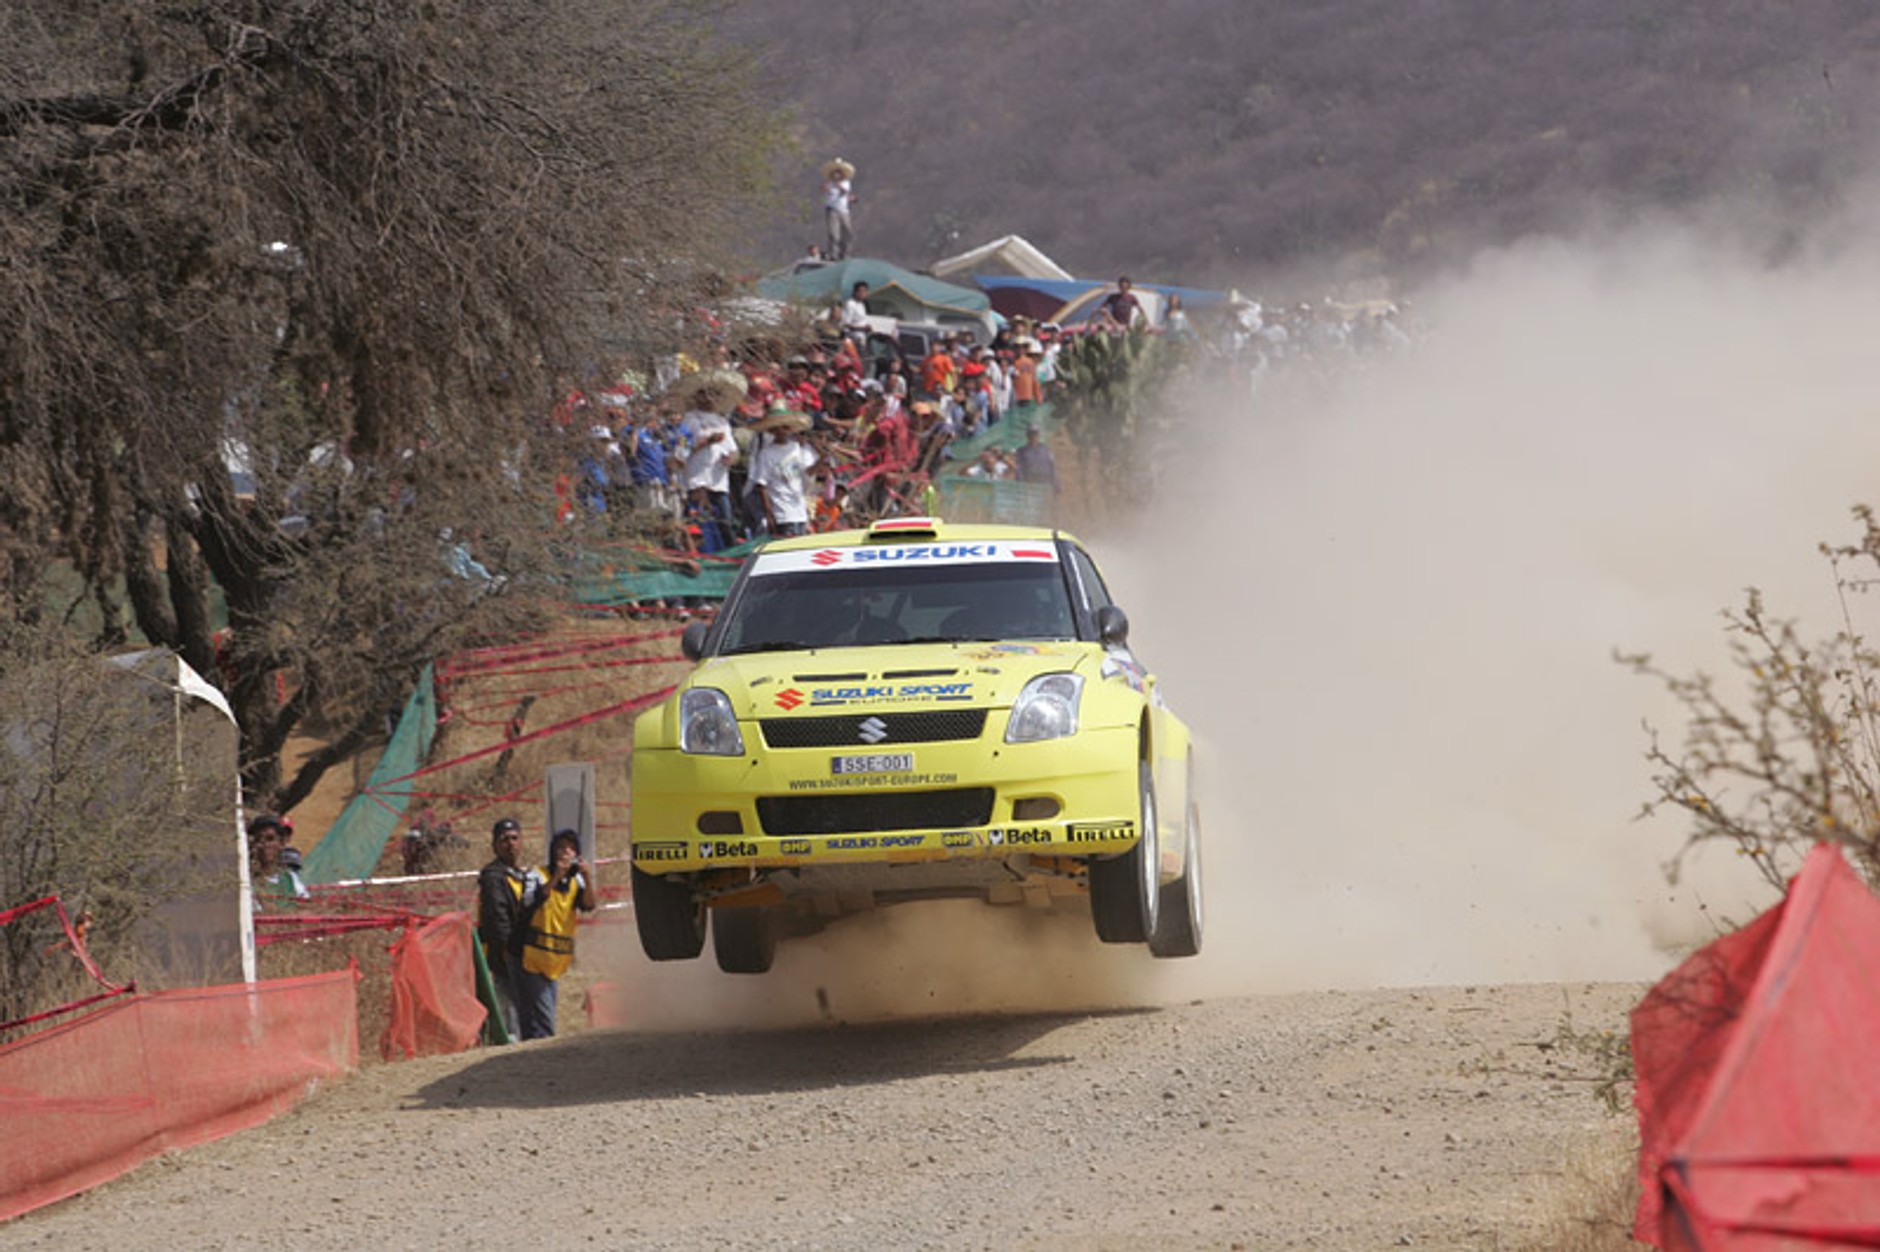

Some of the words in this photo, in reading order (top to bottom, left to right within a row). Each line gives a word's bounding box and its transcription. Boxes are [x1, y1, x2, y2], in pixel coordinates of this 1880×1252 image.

[853, 545, 997, 561] SUZUKI
[811, 686, 893, 699] SUZUKI
[898, 683, 974, 696] SPORT
[845, 756, 910, 772] SSE-001
[1008, 828, 1052, 843] Beta
[1067, 820, 1134, 841] PIRELLI
[715, 841, 758, 857] Beta
[880, 835, 925, 847] SPORT
